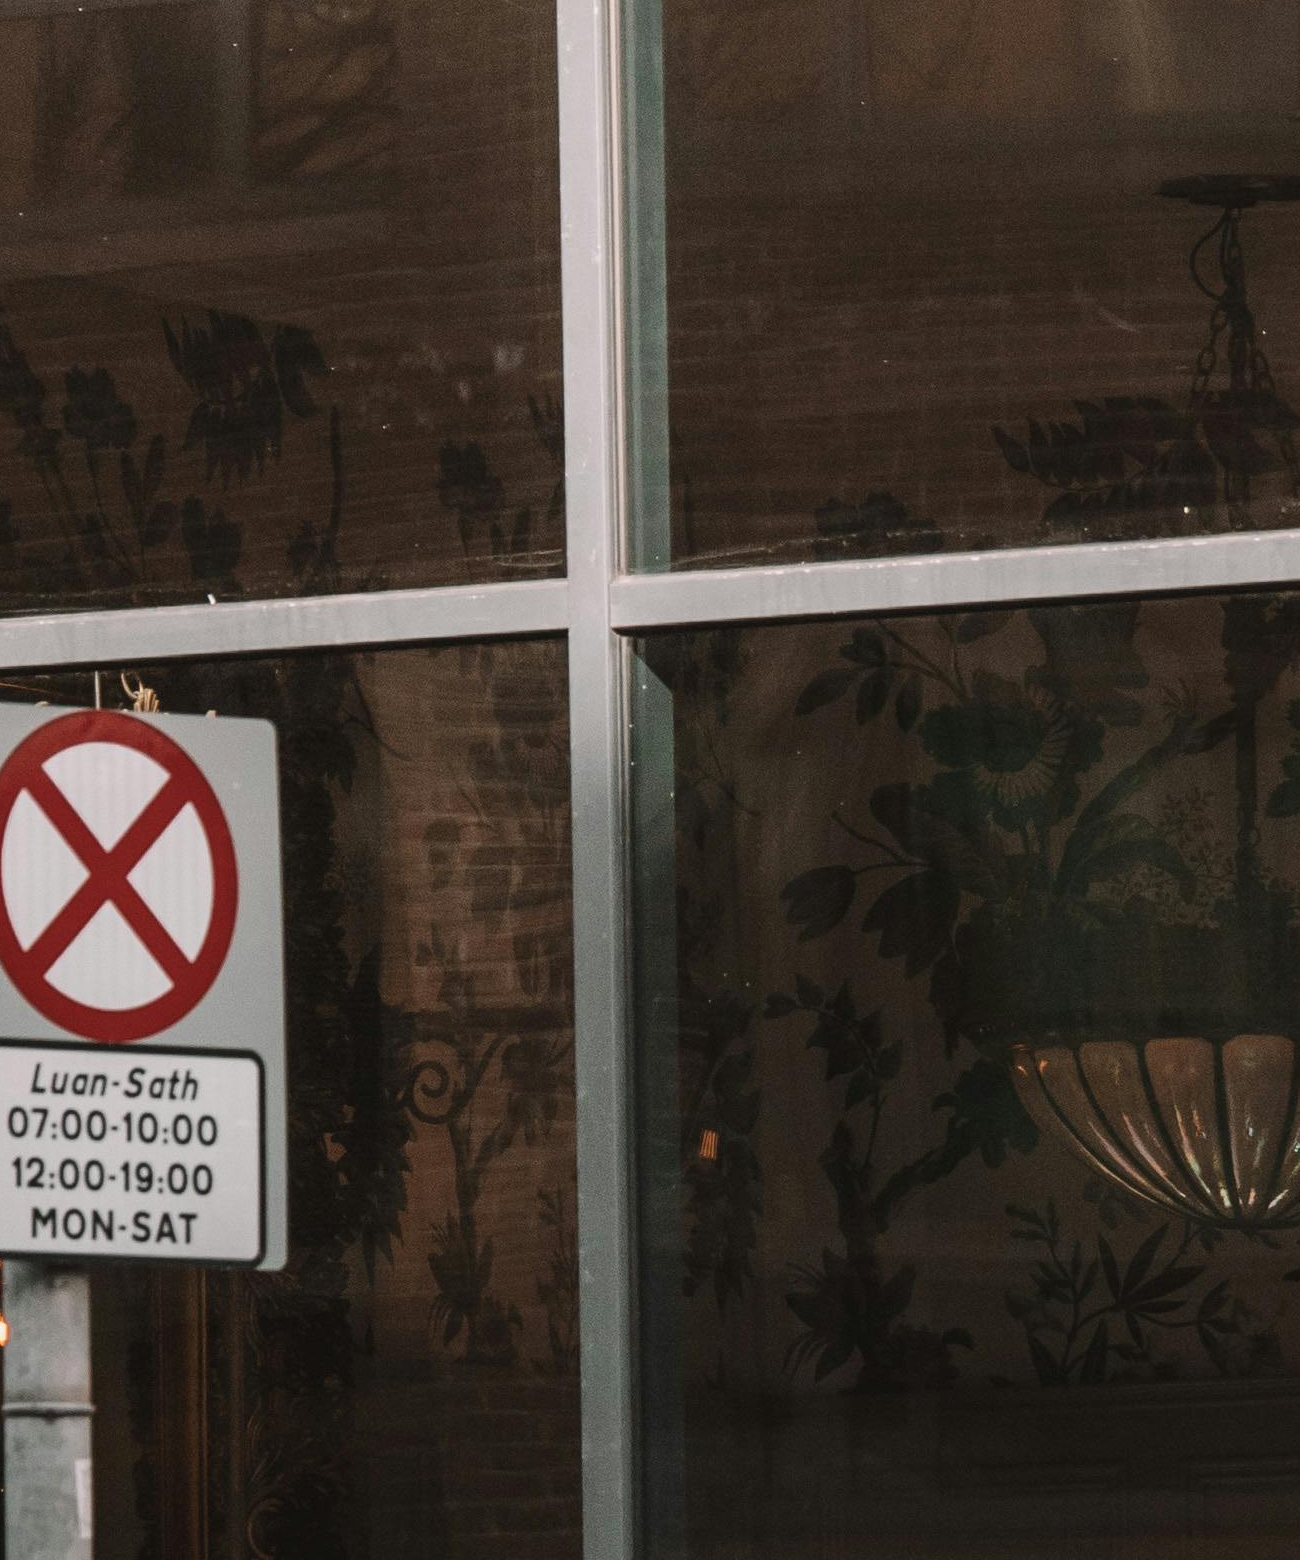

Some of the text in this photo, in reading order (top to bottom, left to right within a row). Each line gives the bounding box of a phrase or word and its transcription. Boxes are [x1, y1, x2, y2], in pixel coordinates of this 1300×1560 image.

[30, 1062, 200, 1102] Luan-Sath
[7, 1106, 218, 1147] 07:00-10:00
[11, 1156, 214, 1197] 12:00-19:00
[31, 1207, 198, 1245] MON-SAT
